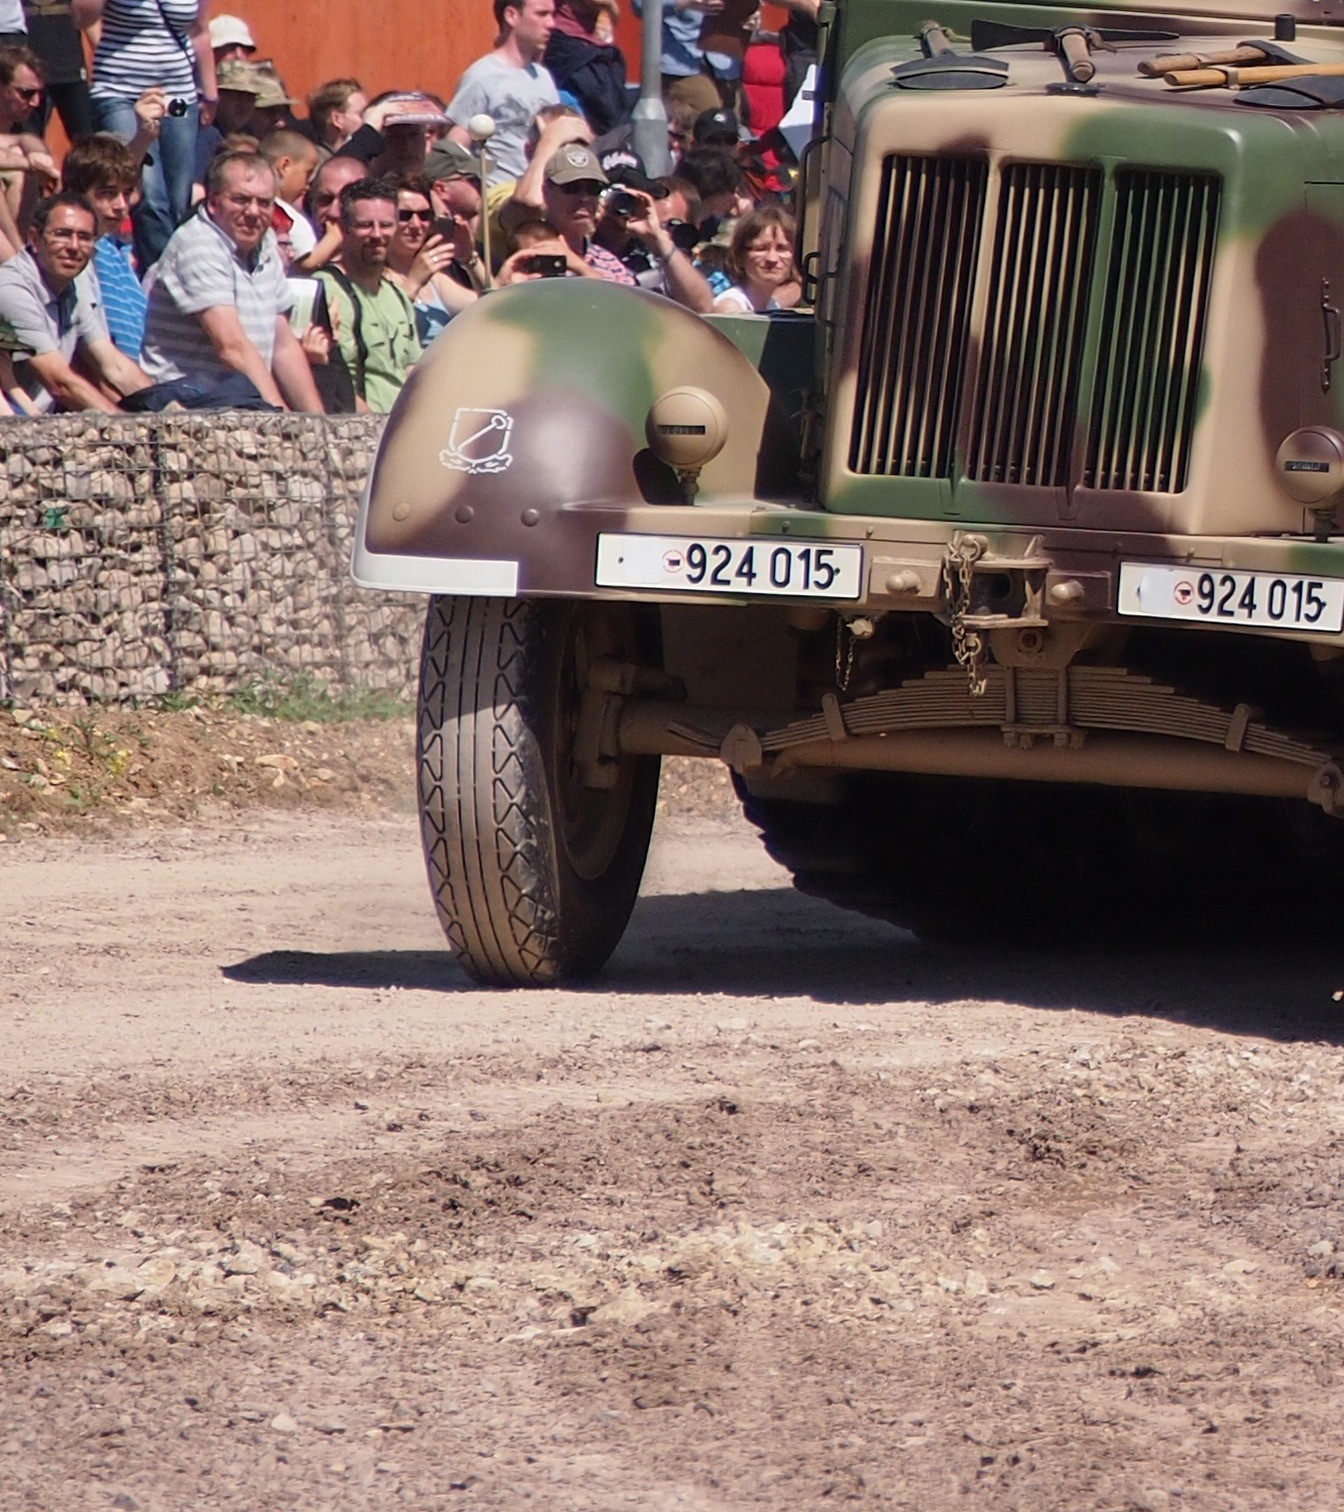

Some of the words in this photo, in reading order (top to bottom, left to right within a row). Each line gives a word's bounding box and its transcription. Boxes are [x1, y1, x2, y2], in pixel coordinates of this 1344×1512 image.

[686, 543, 757, 587] 924
[769, 547, 835, 590] 015
[1197, 573, 1257, 619] 924
[1268, 579, 1324, 623] 015
